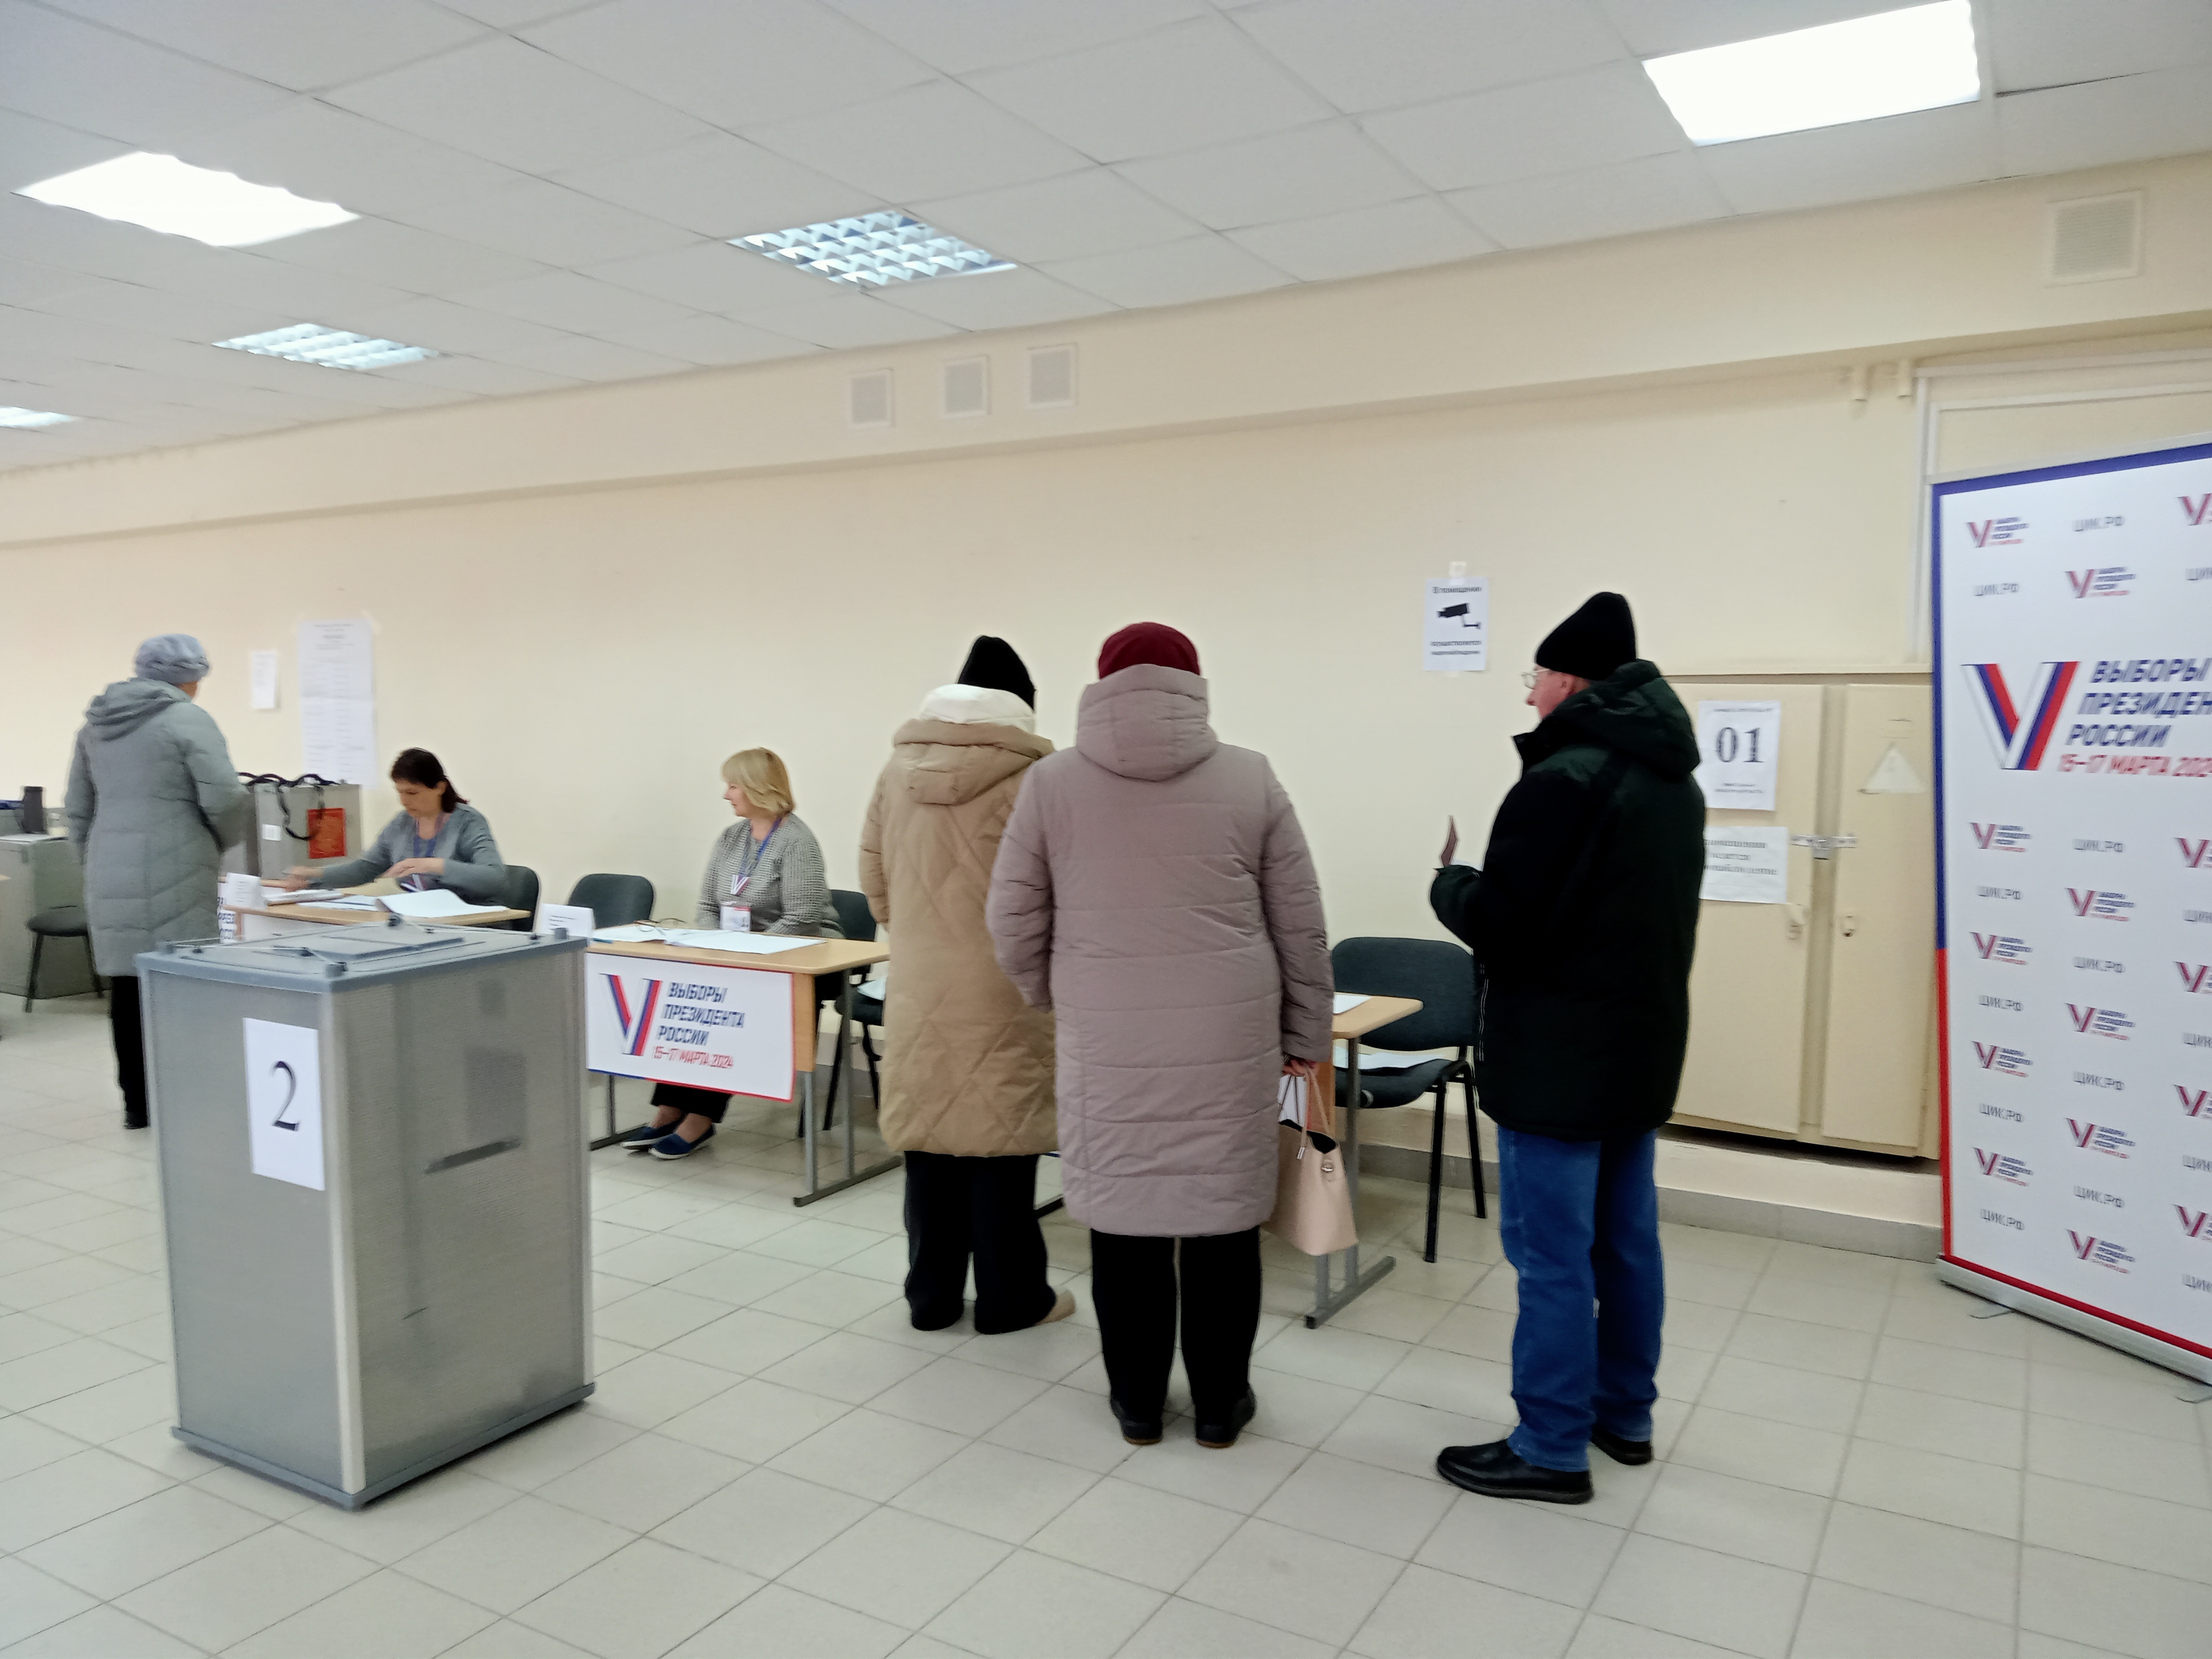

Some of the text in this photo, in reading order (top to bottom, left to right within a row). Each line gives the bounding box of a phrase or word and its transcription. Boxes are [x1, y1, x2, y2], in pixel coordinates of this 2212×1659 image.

[2089, 658, 2212, 683] ВЫБОРЫ
[1715, 727, 1765, 763] 01
[2065, 724, 2172, 747] РОССИИ
[667, 982, 728, 1003] ВЫБОРЫ
[661, 1003, 745, 1028] ПРЕЗИДЕНТА
[655, 1026, 709, 1046] РОССИИ
[270, 1061, 301, 1132] 2
